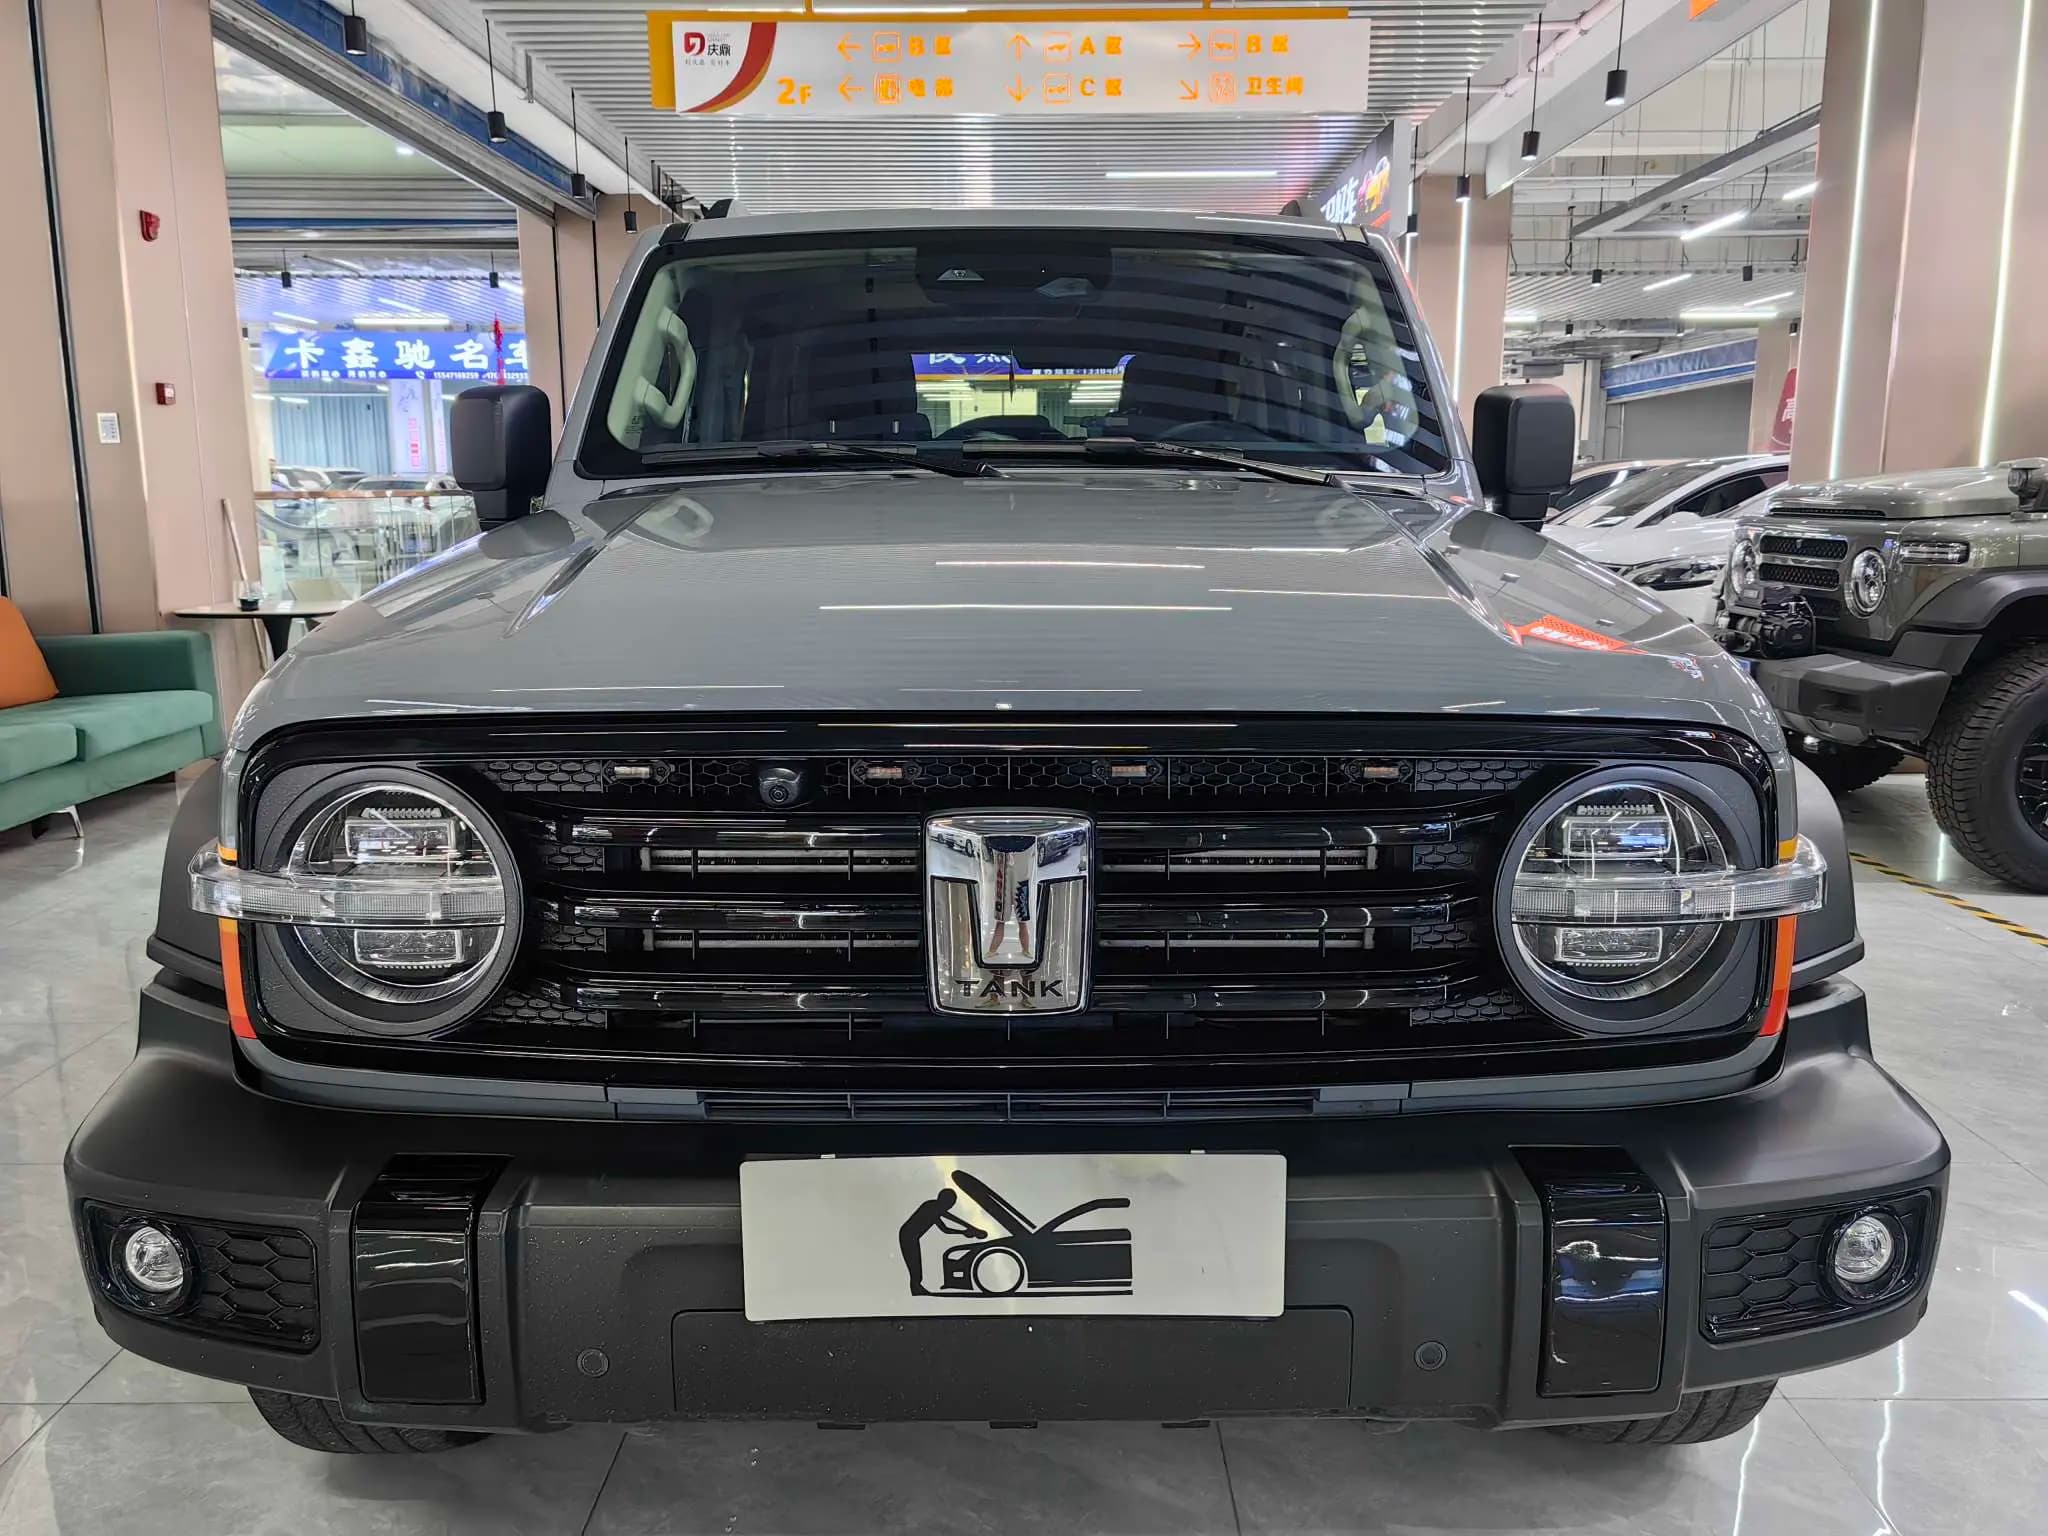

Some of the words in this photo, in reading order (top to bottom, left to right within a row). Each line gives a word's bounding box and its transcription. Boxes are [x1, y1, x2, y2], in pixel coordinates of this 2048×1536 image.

[707, 43, 731, 57] 庆鼎
[777, 78, 812, 105] 2F
[1245, 75, 1304, 96] 卫生间
[955, 979, 1064, 998] TANK
